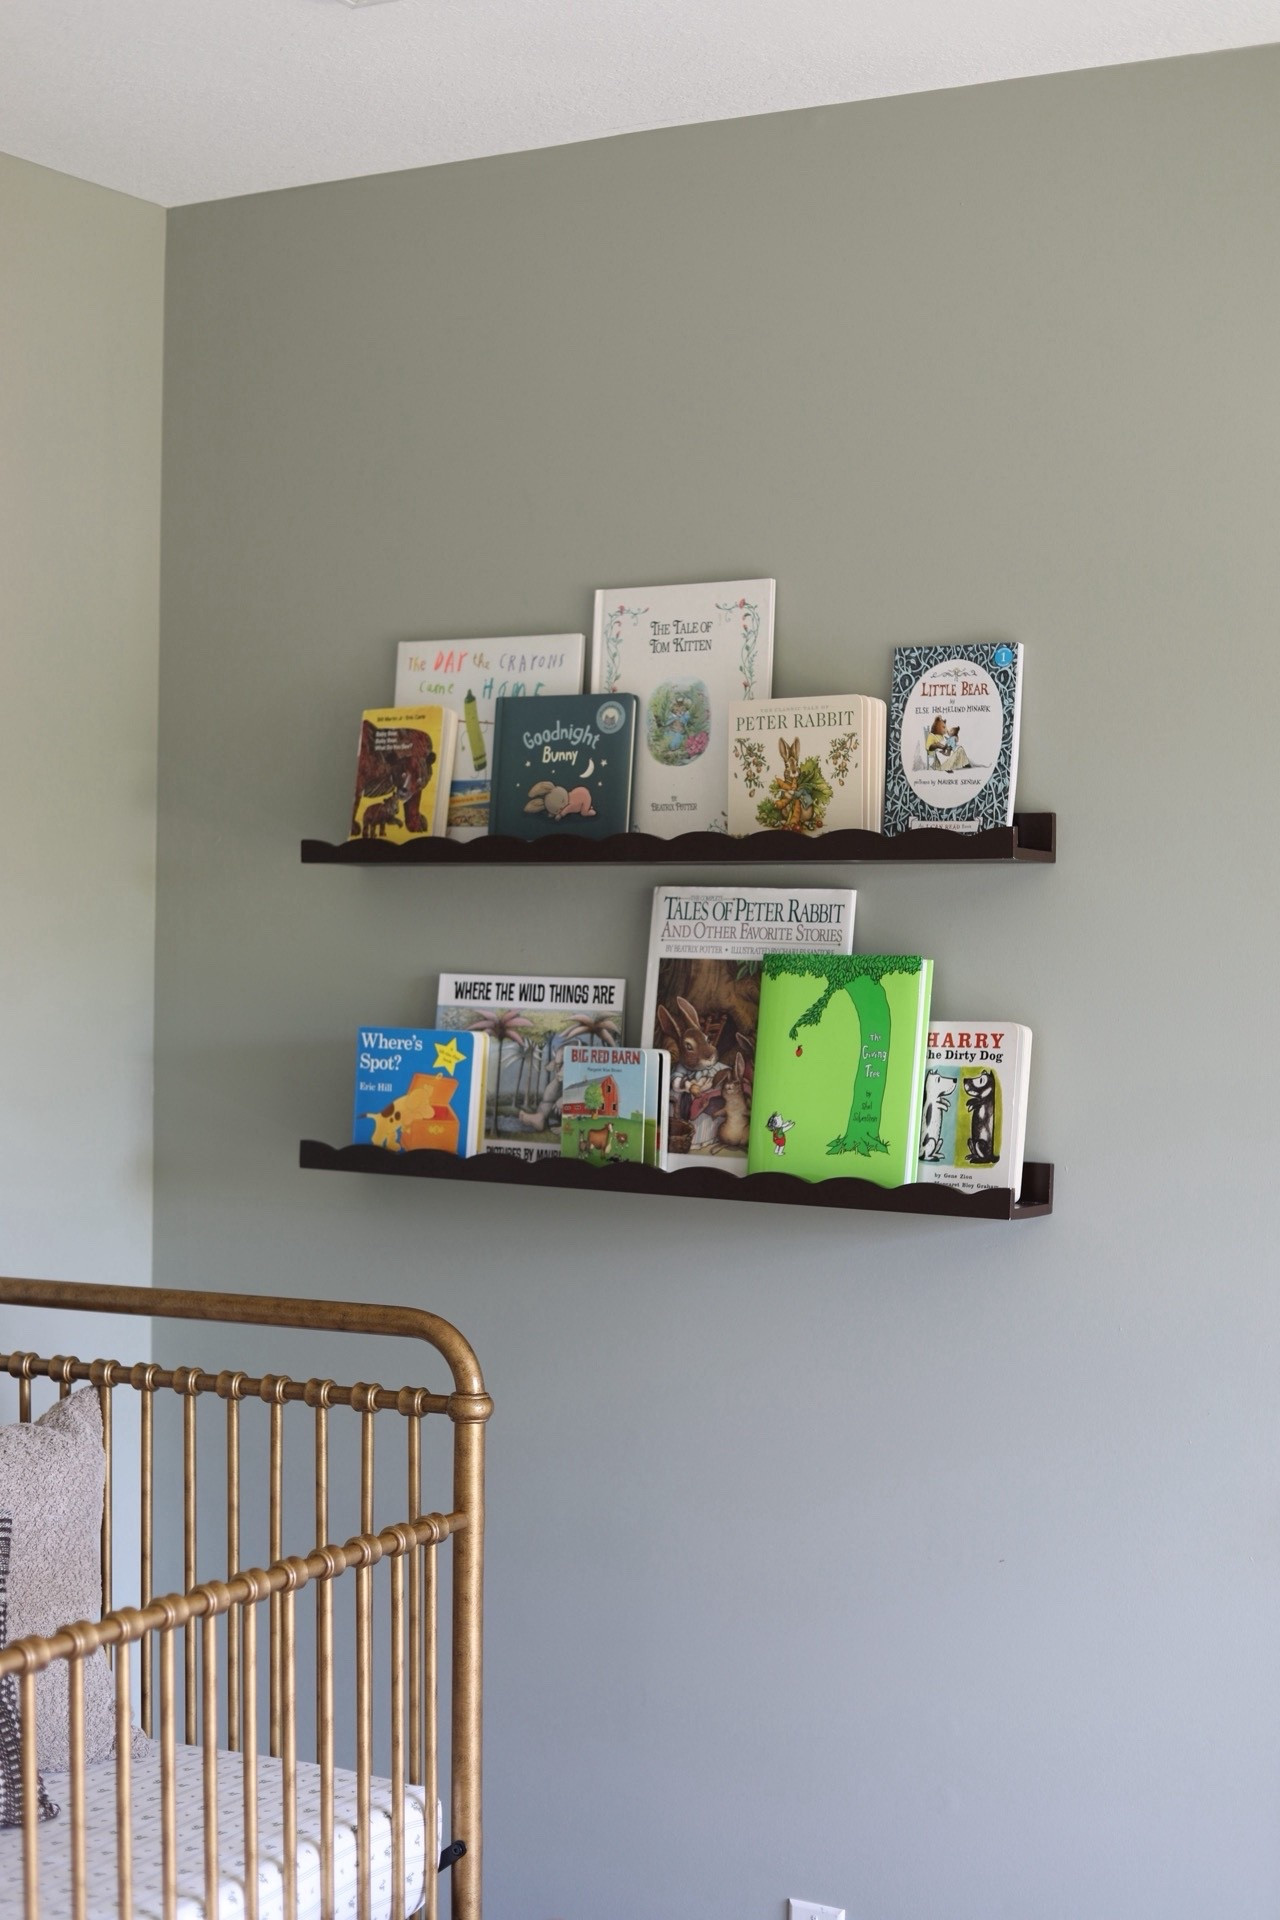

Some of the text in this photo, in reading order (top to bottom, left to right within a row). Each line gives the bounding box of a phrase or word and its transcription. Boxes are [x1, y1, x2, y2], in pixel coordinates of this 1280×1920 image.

[650, 619, 713, 636] THE TALE OF
[649, 637, 713, 654] TOM KITTEN
[408, 656, 426, 672] The
[433, 651, 468, 673] DAY
[473, 652, 490, 670] the
[1000, 652, 1006, 662] 1
[920, 681, 990, 697] LITTLE BEAR
[736, 710, 854, 732] PETER RABBIT
[523, 720, 600, 749] Goodnight
[542, 746, 578, 766] Bunny
[664, 896, 845, 924] TALES OF PETER RABBIT
[661, 921, 843, 943] AND OTHER FAVORITE STORIES
[454, 981, 615, 1005] WHERE THE WILD THINGS ARE
[361, 1032, 423, 1051] Where's
[928, 1032, 1005, 1049] HARRY
[571, 1048, 640, 1065] BIG RED BARN
[862, 1045, 887, 1061] Giving
[927, 1050, 1004, 1063] he Dirty Dog
[359, 1053, 402, 1072] Spot?
[865, 1064, 880, 1078] Tree
[359, 1081, 392, 1092] Eric Hill
